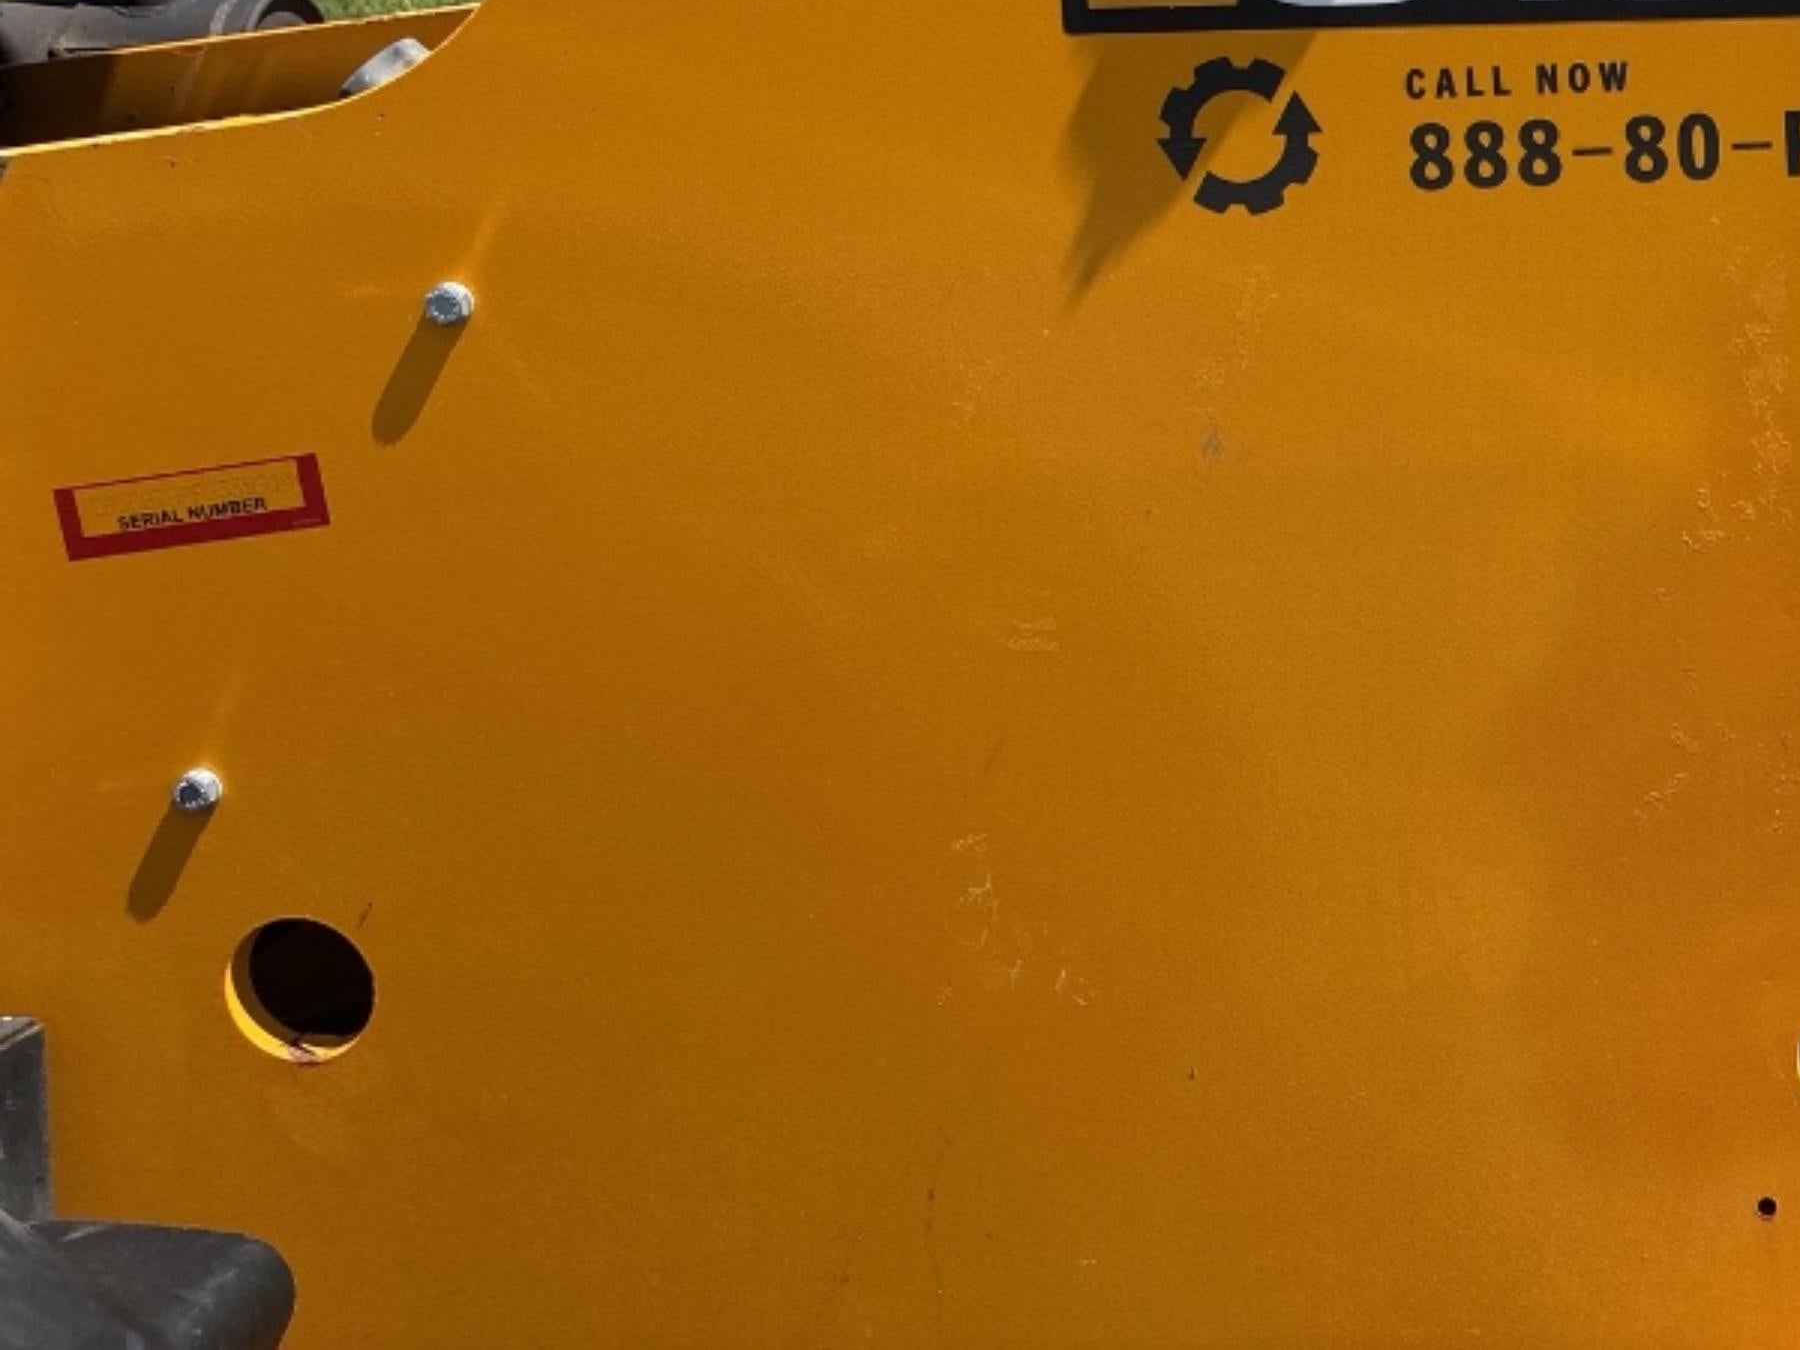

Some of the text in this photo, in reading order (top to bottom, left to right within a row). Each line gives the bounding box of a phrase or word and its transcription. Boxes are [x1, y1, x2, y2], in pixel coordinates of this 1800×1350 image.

[1405, 61, 1629, 100] CALL NOW
[117, 496, 268, 530] SERIAL NUMBER
